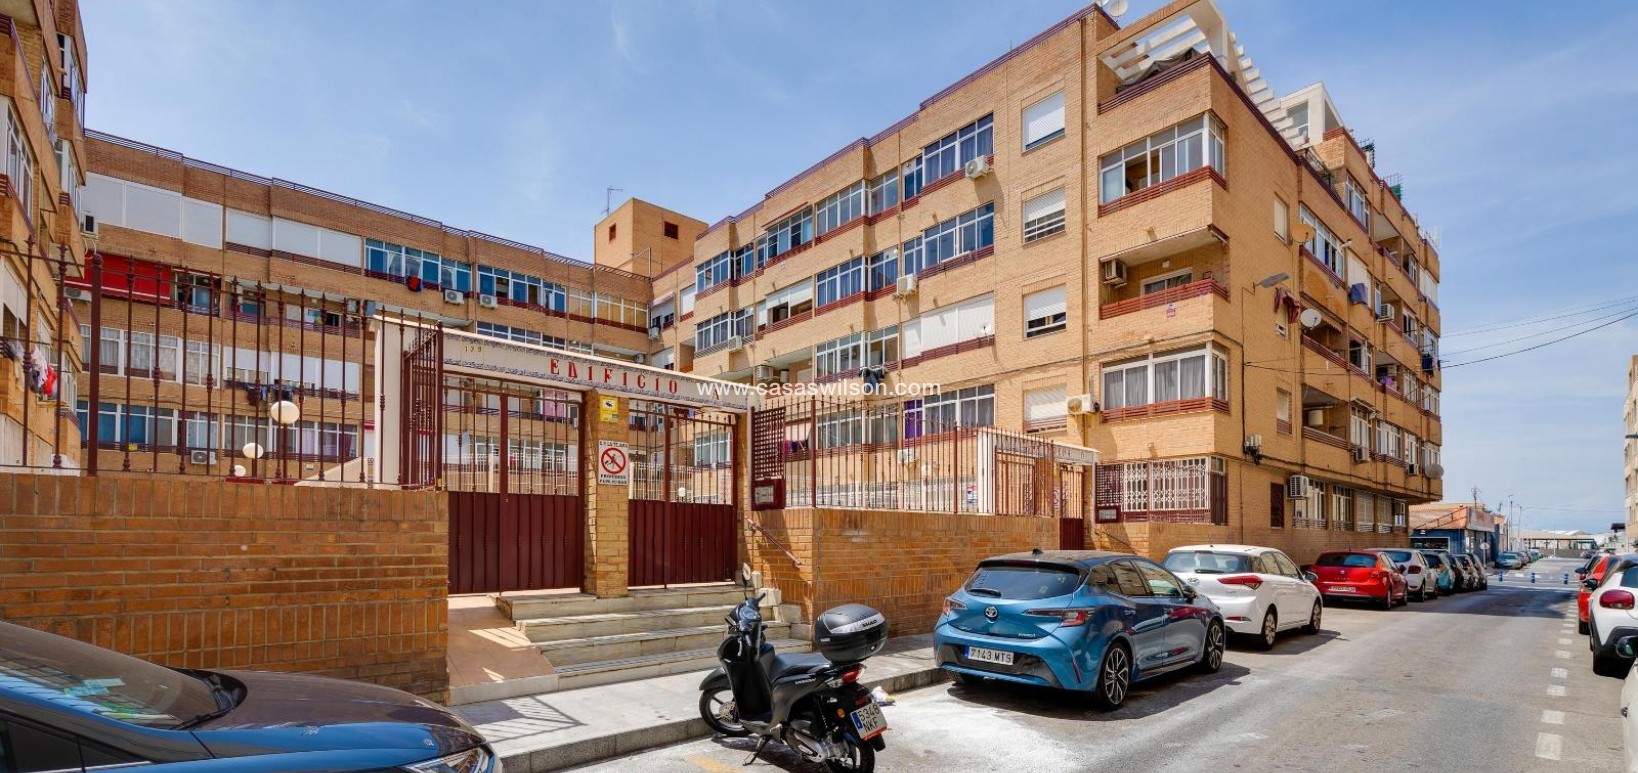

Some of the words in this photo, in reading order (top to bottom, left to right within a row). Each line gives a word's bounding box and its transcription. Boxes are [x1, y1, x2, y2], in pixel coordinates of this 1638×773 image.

[550, 358, 677, 394] EDIFICIO
[970, 648, 992, 660] 7143
[994, 652, 1012, 663] MTS
[858, 704, 879, 721] 5348
